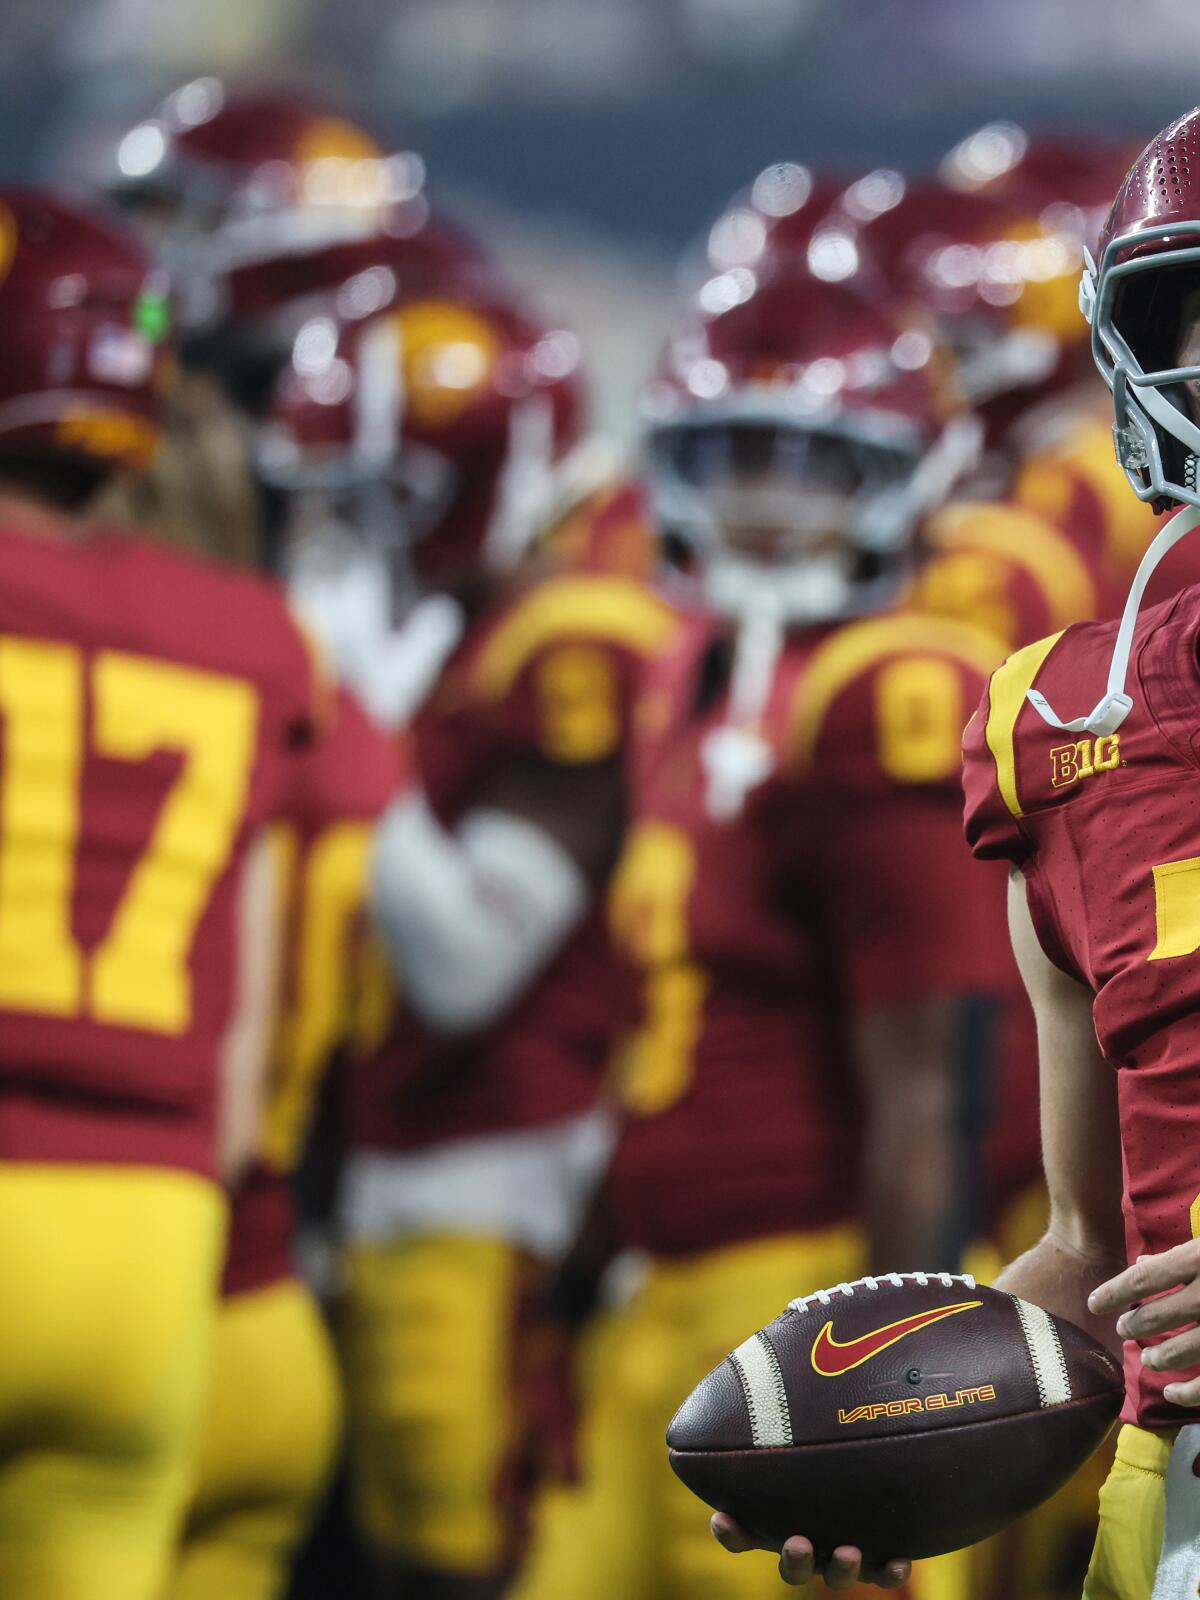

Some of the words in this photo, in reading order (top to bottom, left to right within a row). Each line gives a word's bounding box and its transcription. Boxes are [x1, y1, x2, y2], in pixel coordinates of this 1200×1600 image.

[0, 636, 259, 1036] 17
[838, 1398, 924, 1424] VAPOR
[925, 1384, 996, 1411] ELITE
